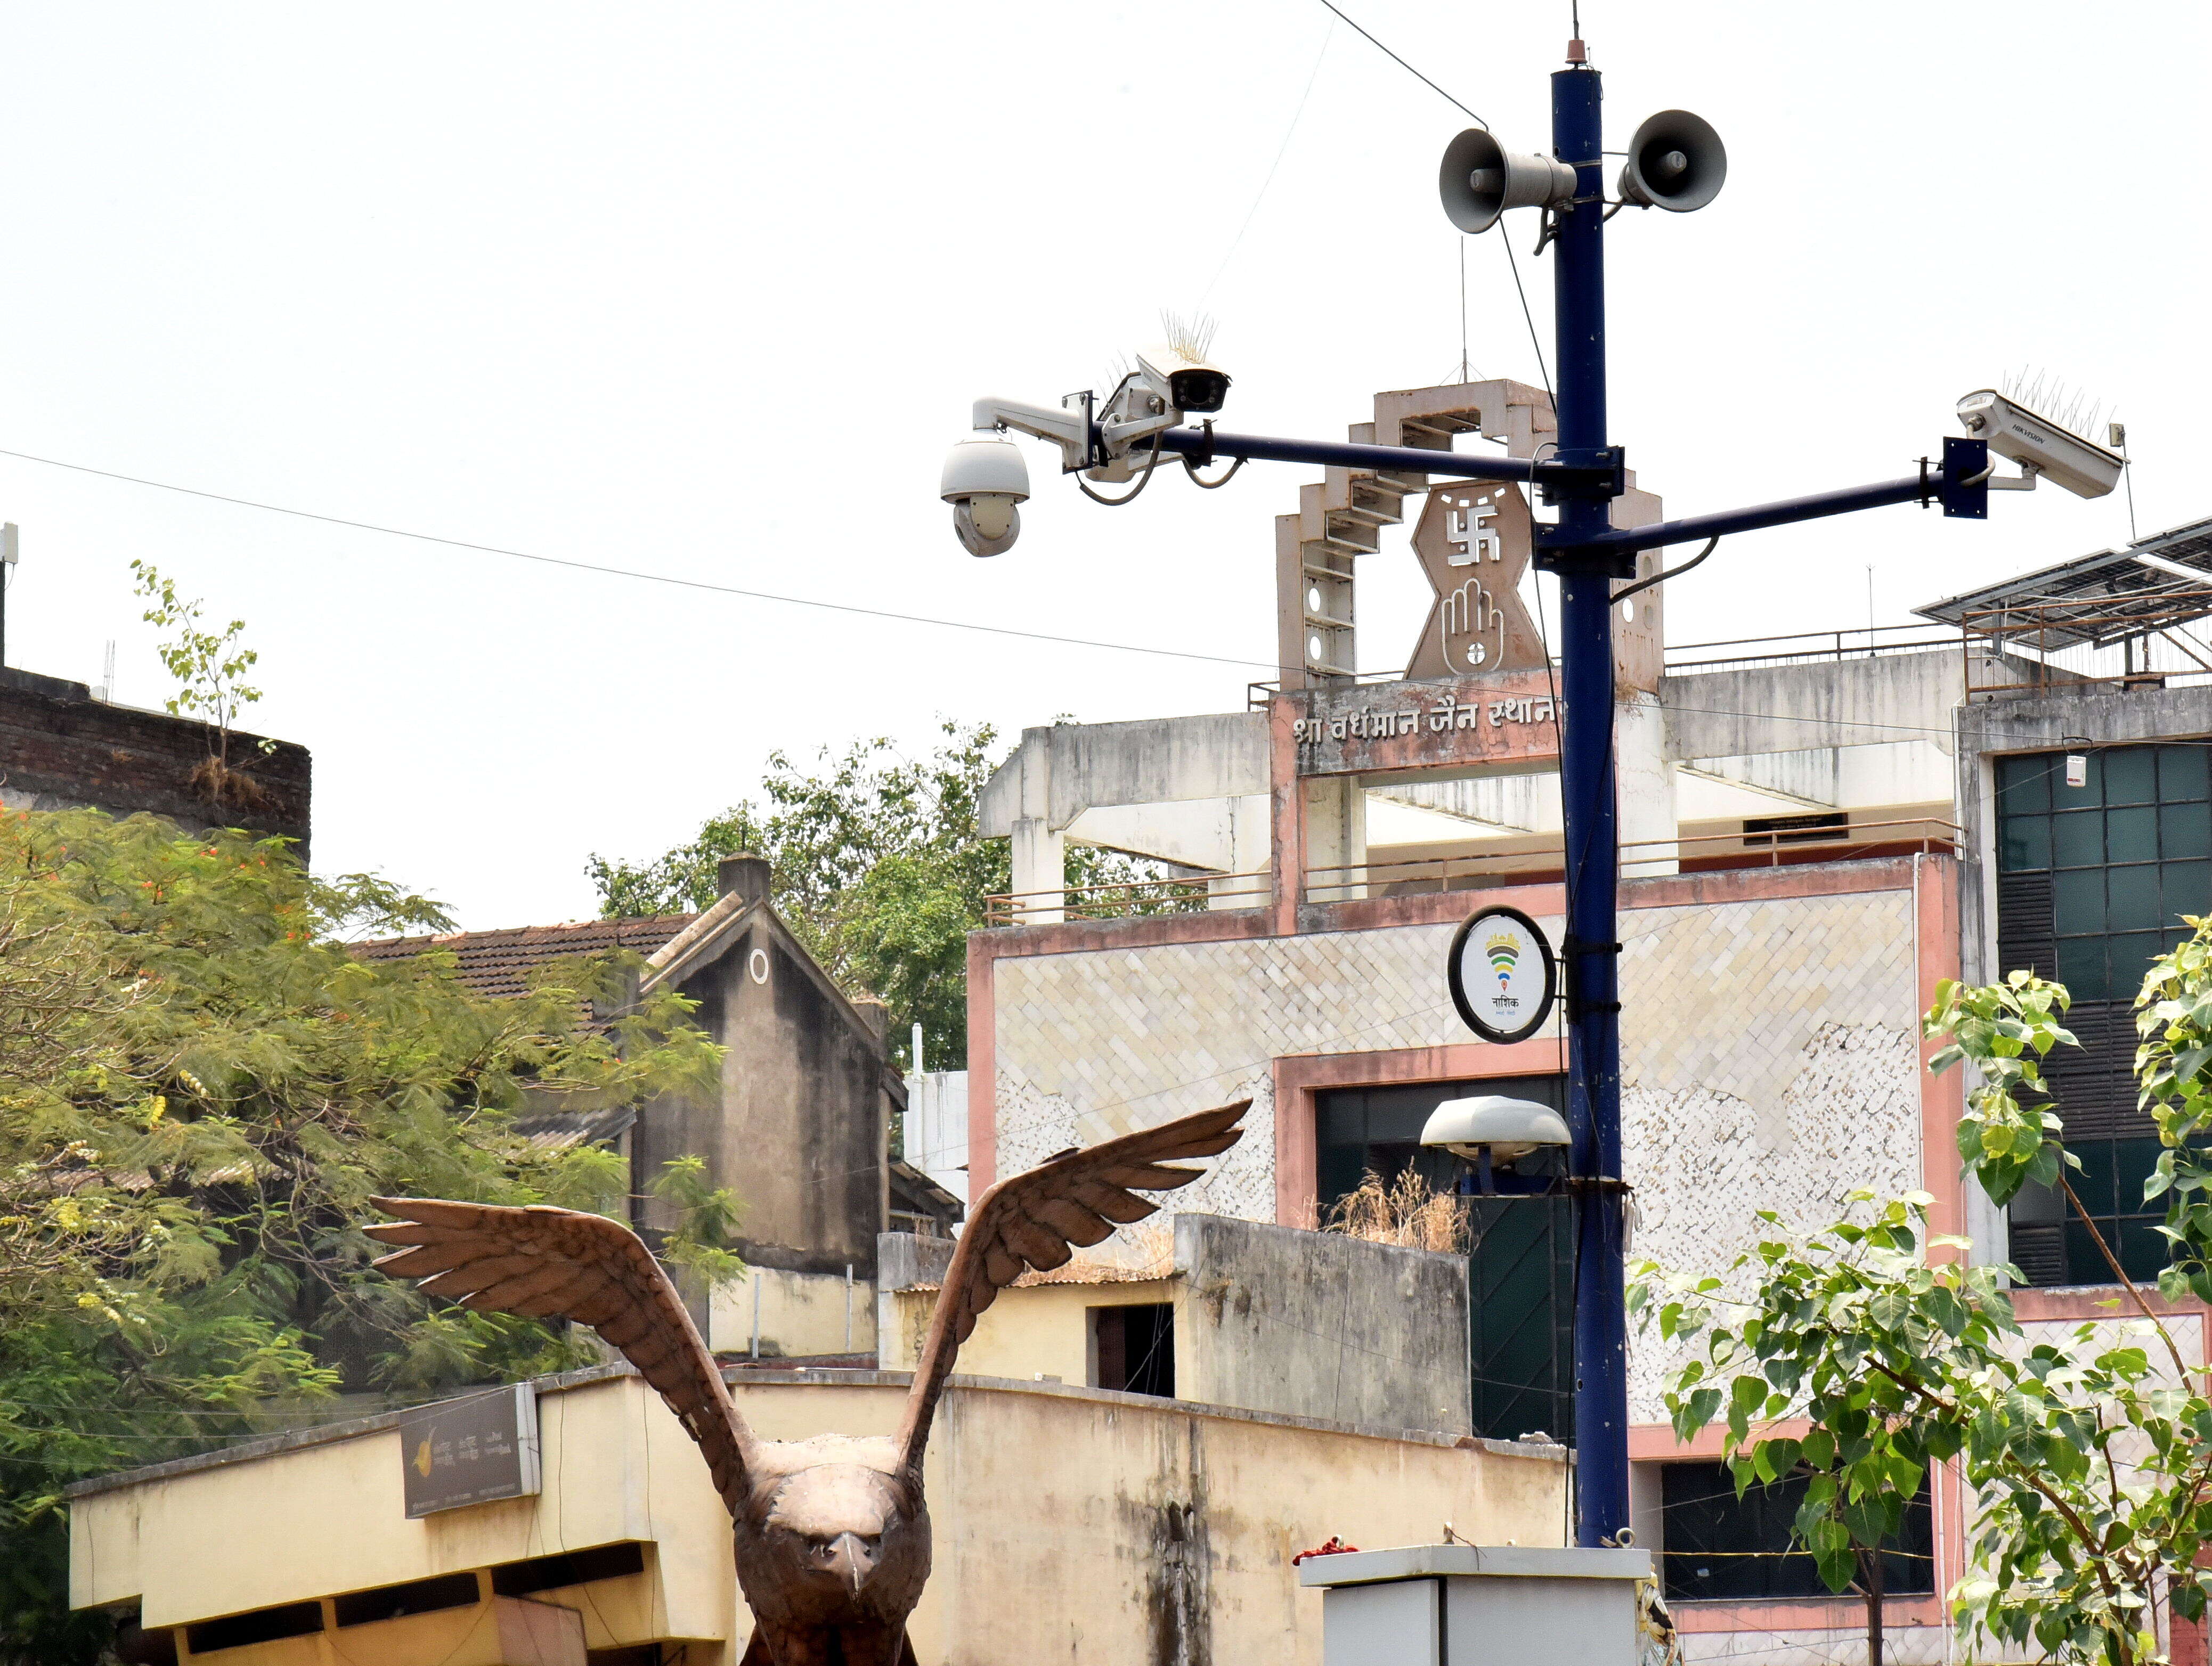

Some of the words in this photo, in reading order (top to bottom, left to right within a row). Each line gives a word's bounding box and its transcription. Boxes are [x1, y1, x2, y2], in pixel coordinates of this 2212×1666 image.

[2012, 424, 2046, 444] HIKVISION
[1332, 706, 1421, 739] वर्धमान
[1430, 695, 1478, 732] जैन
[1487, 697, 1563, 727] स्थान
[1491, 994, 1519, 1008] नाशिक
